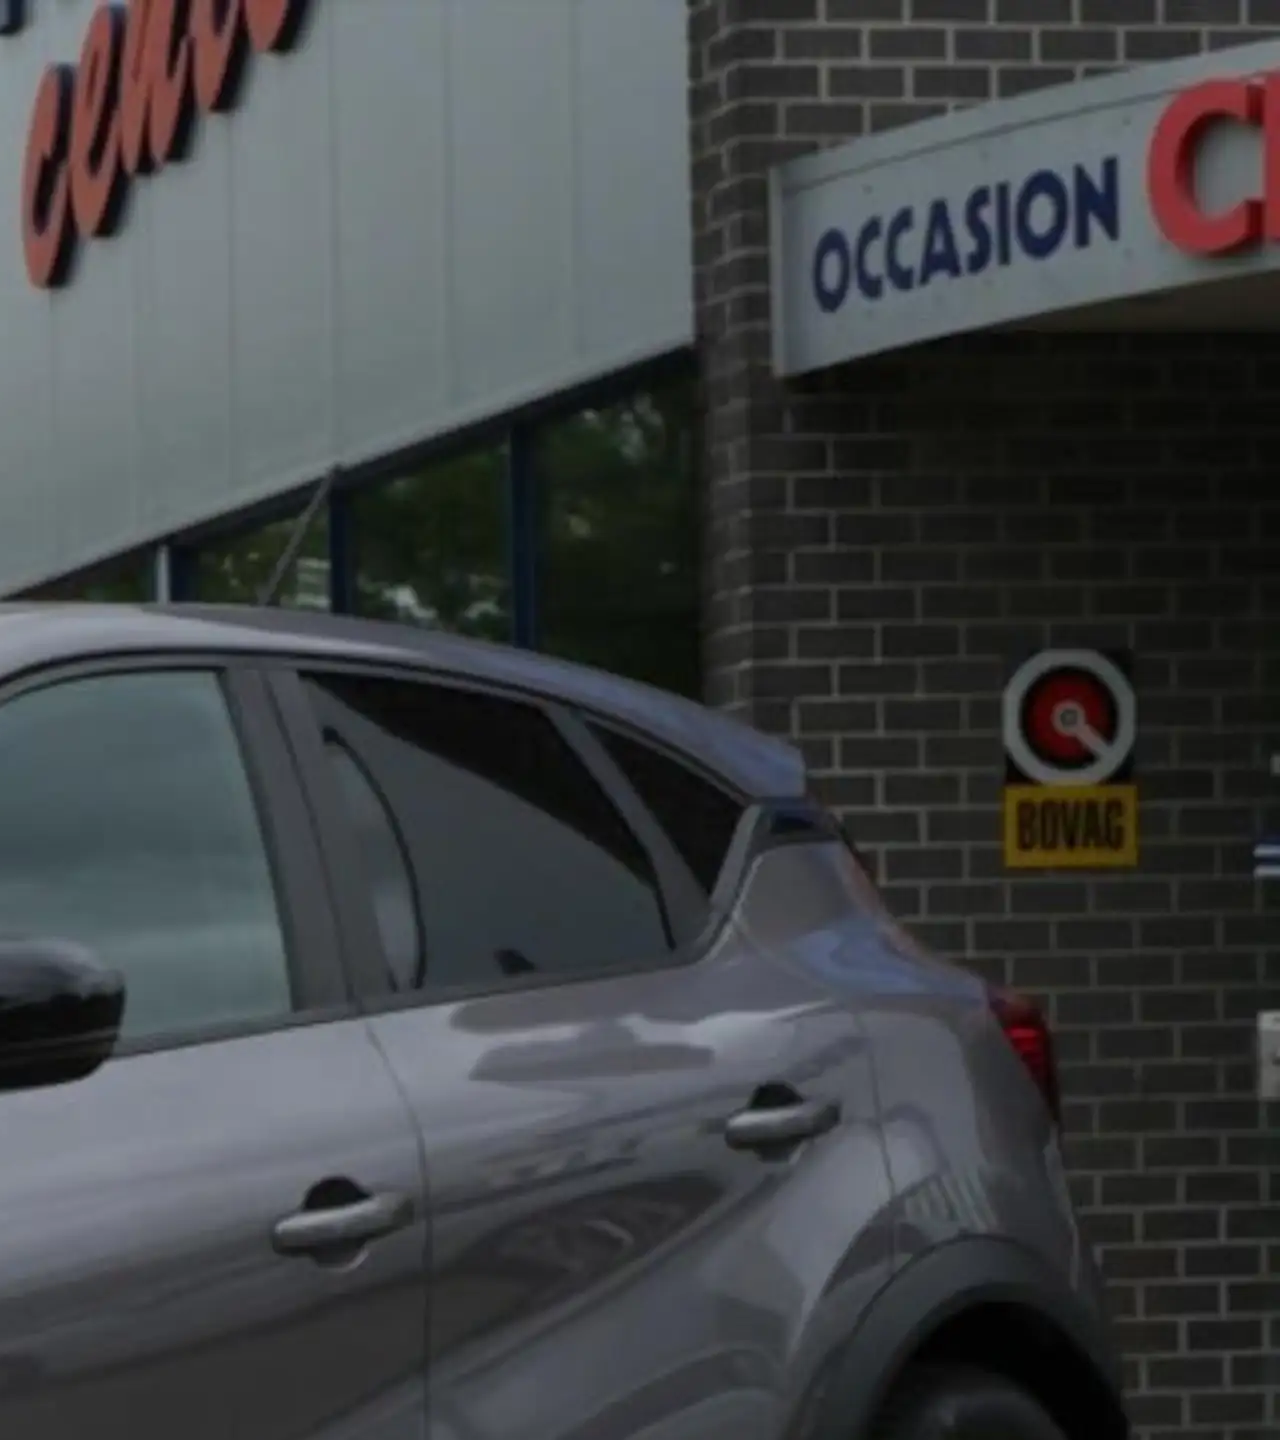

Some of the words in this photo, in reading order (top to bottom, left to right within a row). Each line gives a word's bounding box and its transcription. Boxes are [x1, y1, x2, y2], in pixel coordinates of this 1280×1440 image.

[21, 0, 310, 290] cen
[813, 156, 1120, 313] OCCASION
[1146, 68, 1280, 258] C
[1017, 798, 1125, 851] BOVAG
